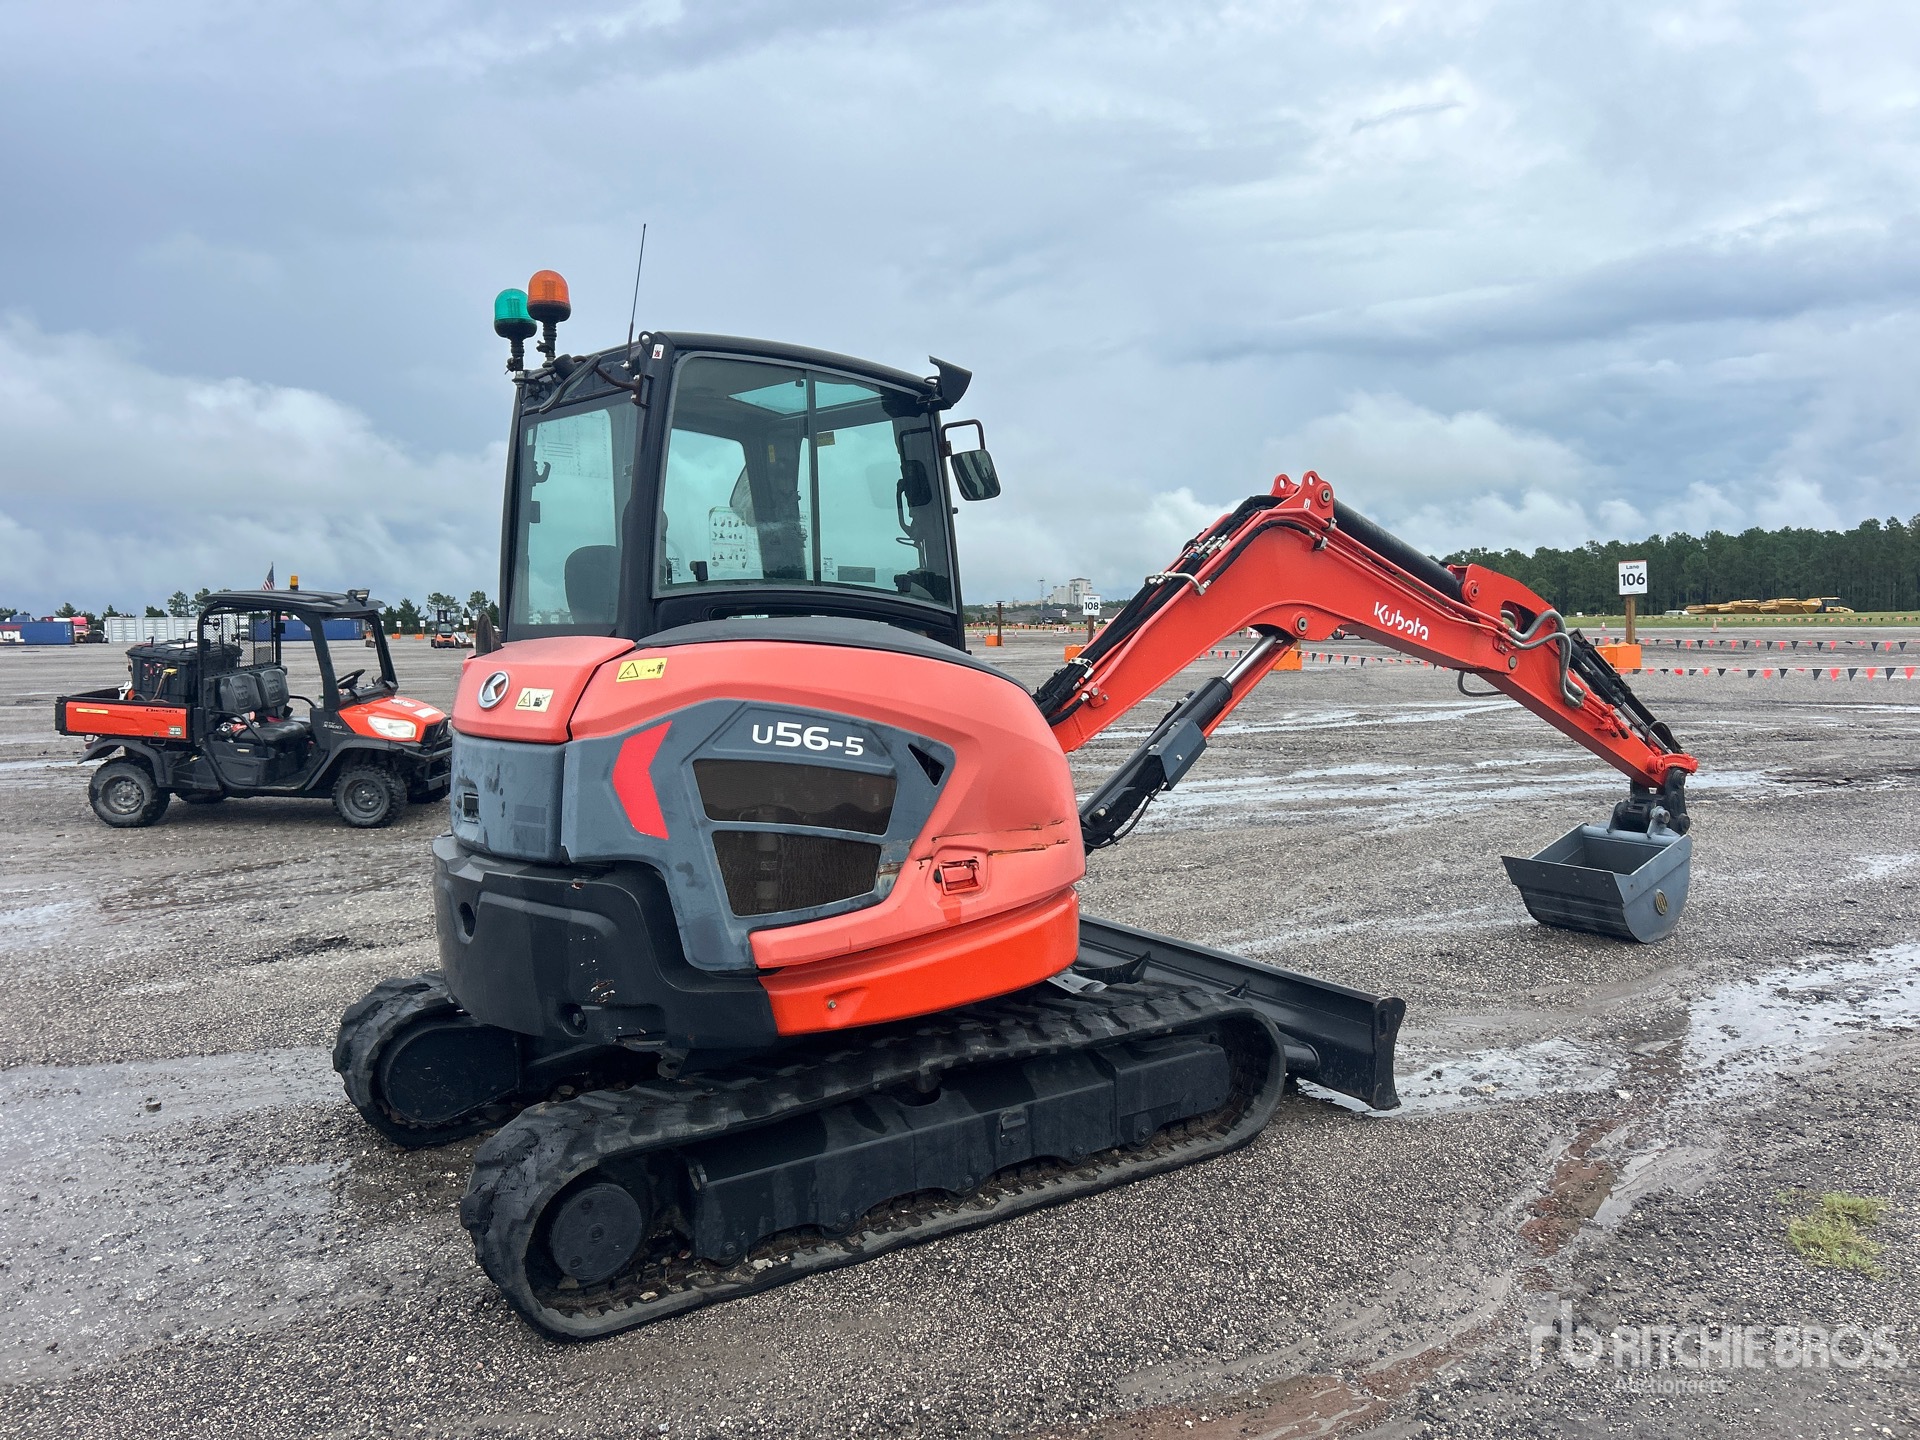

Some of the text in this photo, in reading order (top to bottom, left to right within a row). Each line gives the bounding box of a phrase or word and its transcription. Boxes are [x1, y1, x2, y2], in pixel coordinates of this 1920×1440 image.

[1620, 572, 1646, 586] 106
[1084, 601, 1099, 610] 108
[1373, 601, 1429, 641] Kubota
